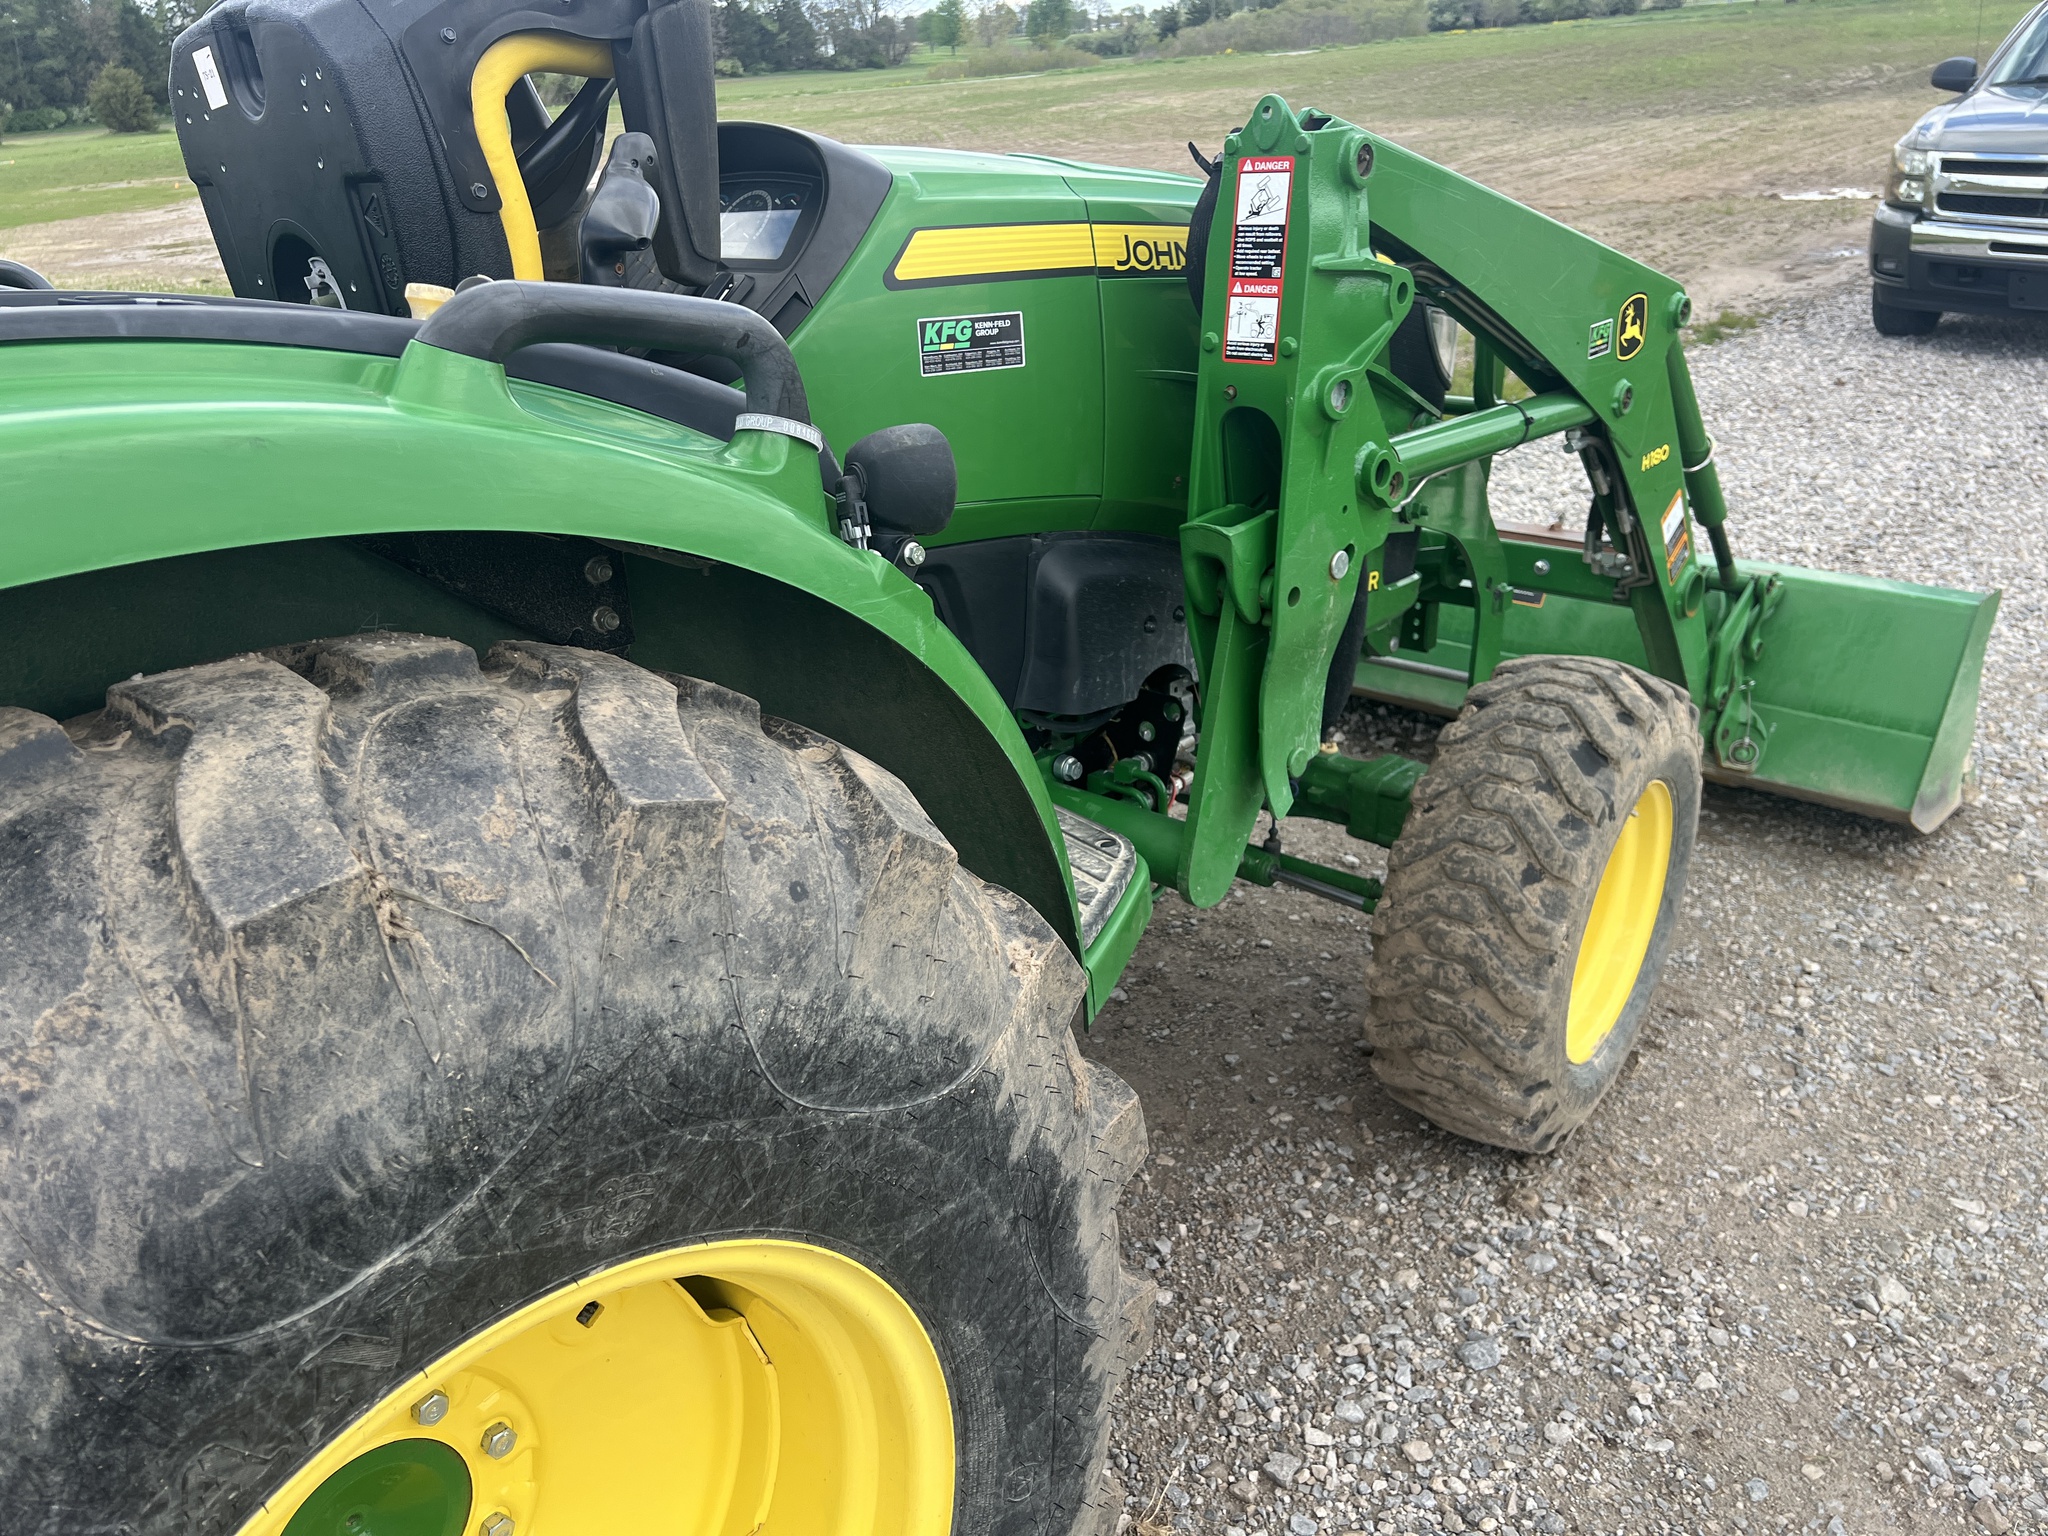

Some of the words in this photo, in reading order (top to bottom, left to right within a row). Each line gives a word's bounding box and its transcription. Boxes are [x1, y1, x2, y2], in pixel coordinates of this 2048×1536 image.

[1254, 161, 1290, 171] DANGER
[1116, 234, 1188, 266] JOHN
[1243, 284, 1279, 294] DANGER
[974, 320, 1011, 329] KENN-FELD
[924, 320, 972, 344] KFG
[975, 328, 1000, 336] GROUP
